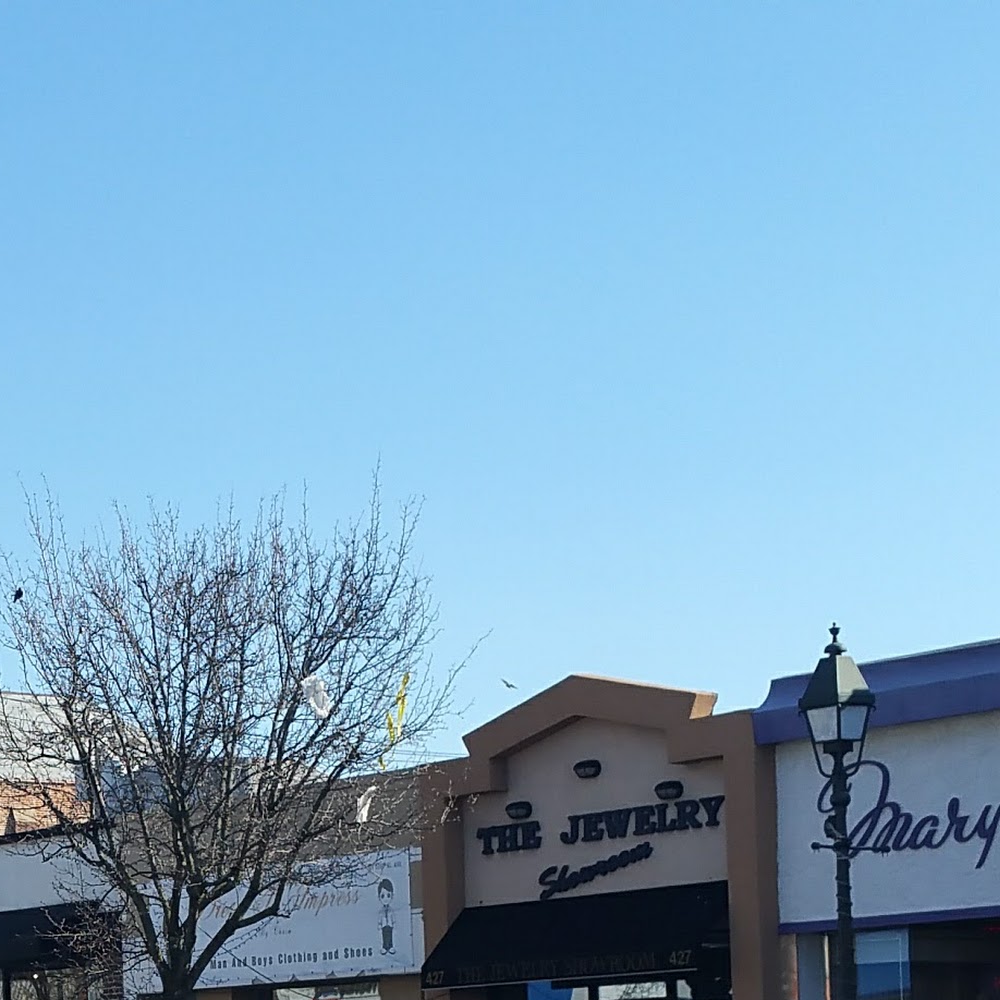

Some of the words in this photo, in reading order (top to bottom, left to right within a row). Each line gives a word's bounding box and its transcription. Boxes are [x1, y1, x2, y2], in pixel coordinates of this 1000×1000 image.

[477, 820, 542, 856] THE
[560, 795, 726, 845] JEWELRY
[538, 841, 654, 900] Showroom
[209, 959, 228, 970] Man
[231, 956, 247, 968] And
[251, 955, 274, 967] Boys
[278, 950, 318, 964] Clothing
[322, 948, 340, 960] and
[343, 946, 374, 959] Shoes
[669, 950, 692, 965] 427
[425, 971, 445, 985] 427
